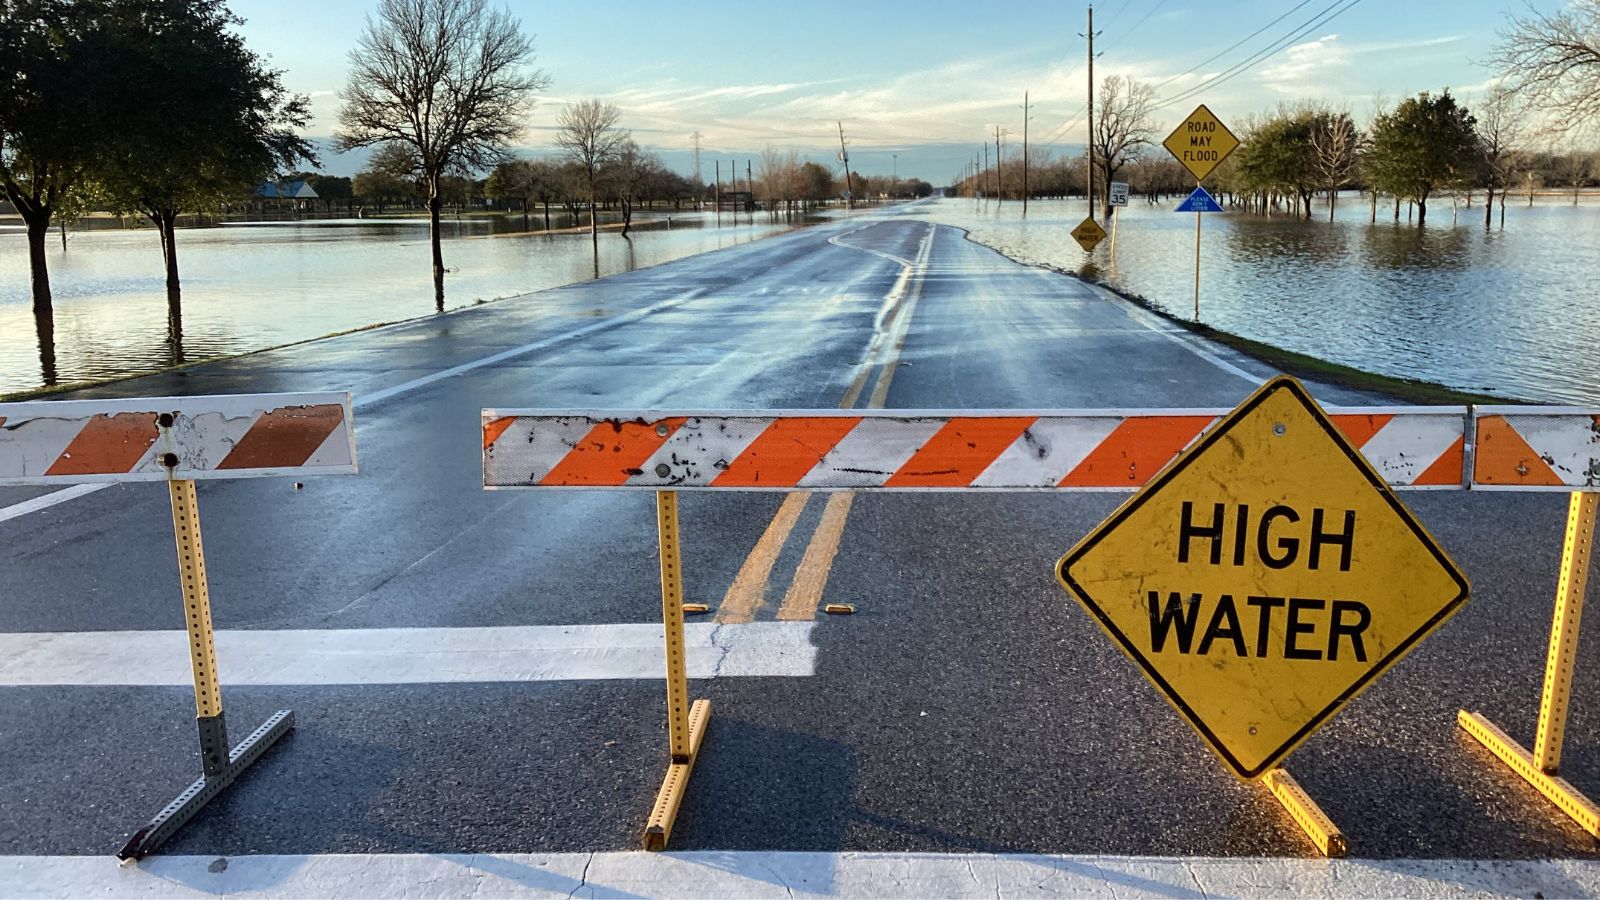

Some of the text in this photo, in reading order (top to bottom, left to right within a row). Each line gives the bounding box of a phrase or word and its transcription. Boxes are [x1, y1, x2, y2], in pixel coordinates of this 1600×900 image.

[1188, 122, 1216, 132] ROAD
[1191, 136, 1212, 147] MAY
[1184, 150, 1218, 161] FLOOD
[1111, 194, 1126, 204] 35
[1078, 234, 1099, 242] WATER
[1178, 501, 1356, 572] HIGH
[1148, 590, 1372, 662] WATER
